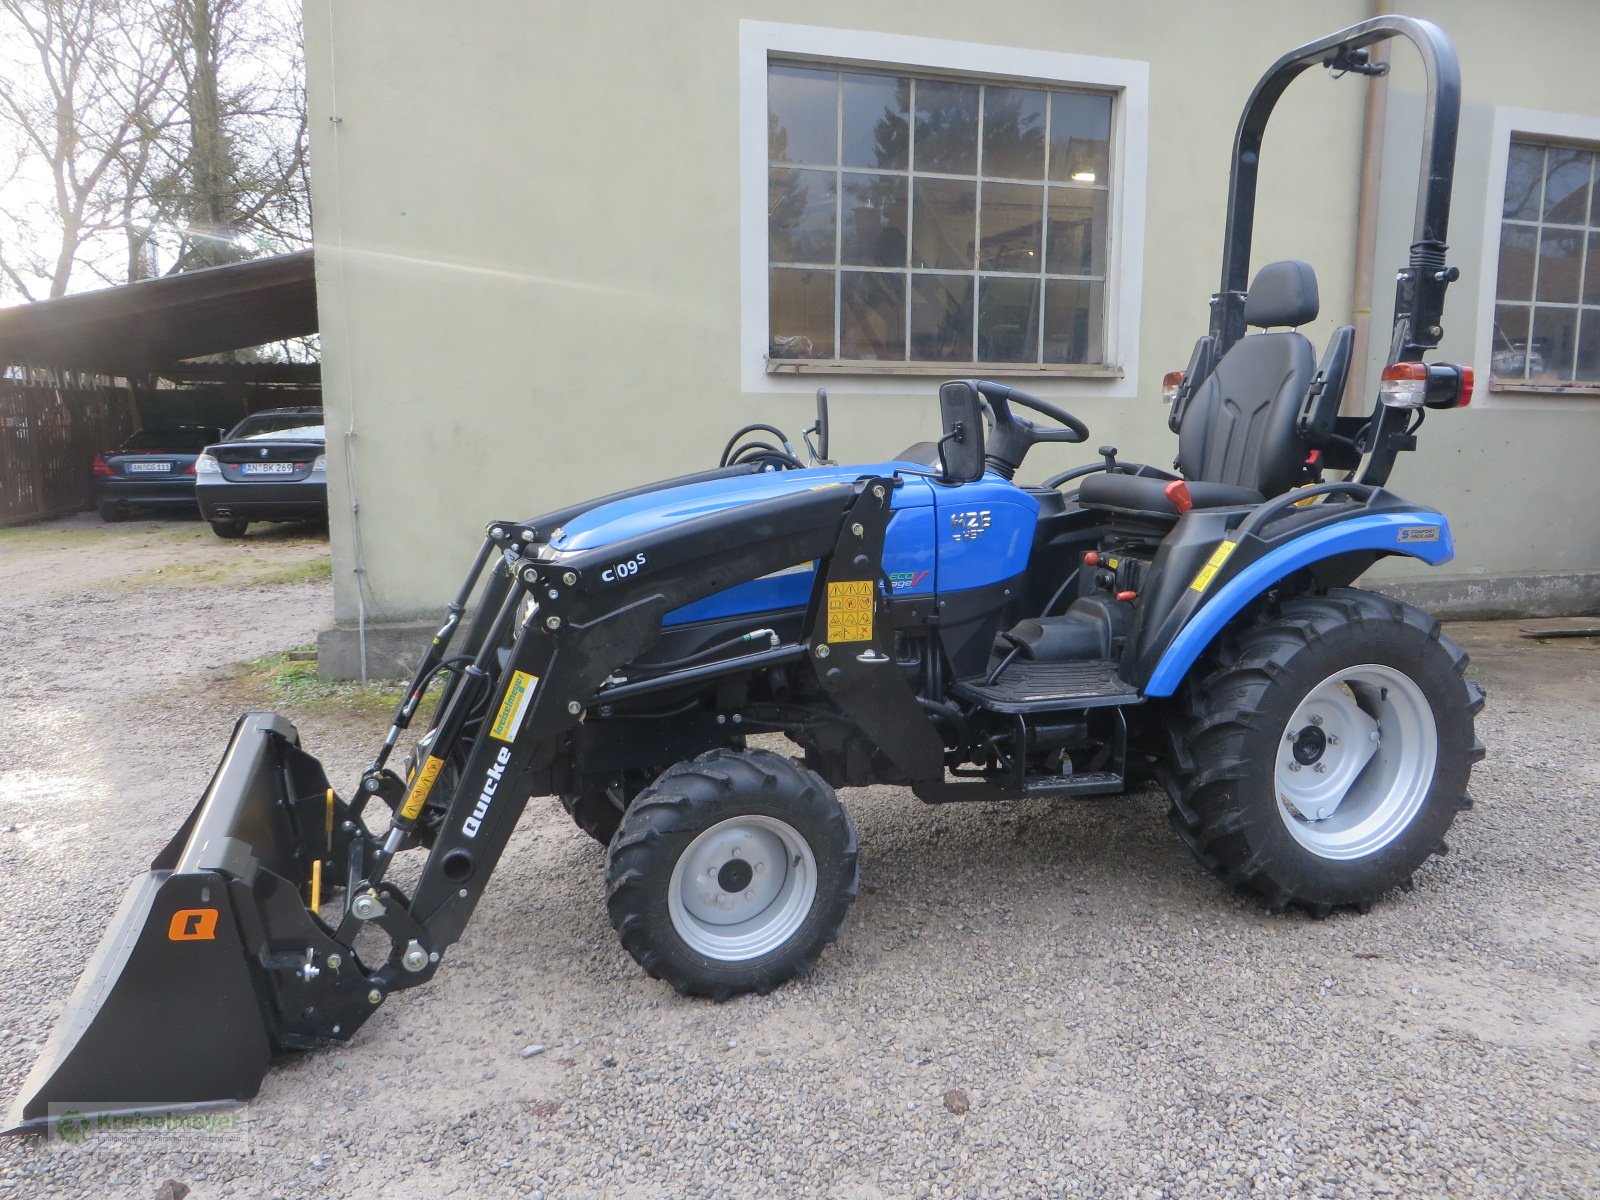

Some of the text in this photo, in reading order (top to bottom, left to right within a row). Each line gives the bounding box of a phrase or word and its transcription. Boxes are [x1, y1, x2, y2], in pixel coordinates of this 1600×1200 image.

[247, 463, 292, 472] AN BK 269
[890, 572, 914, 580] ECO
[462, 746, 512, 838] Quicke
